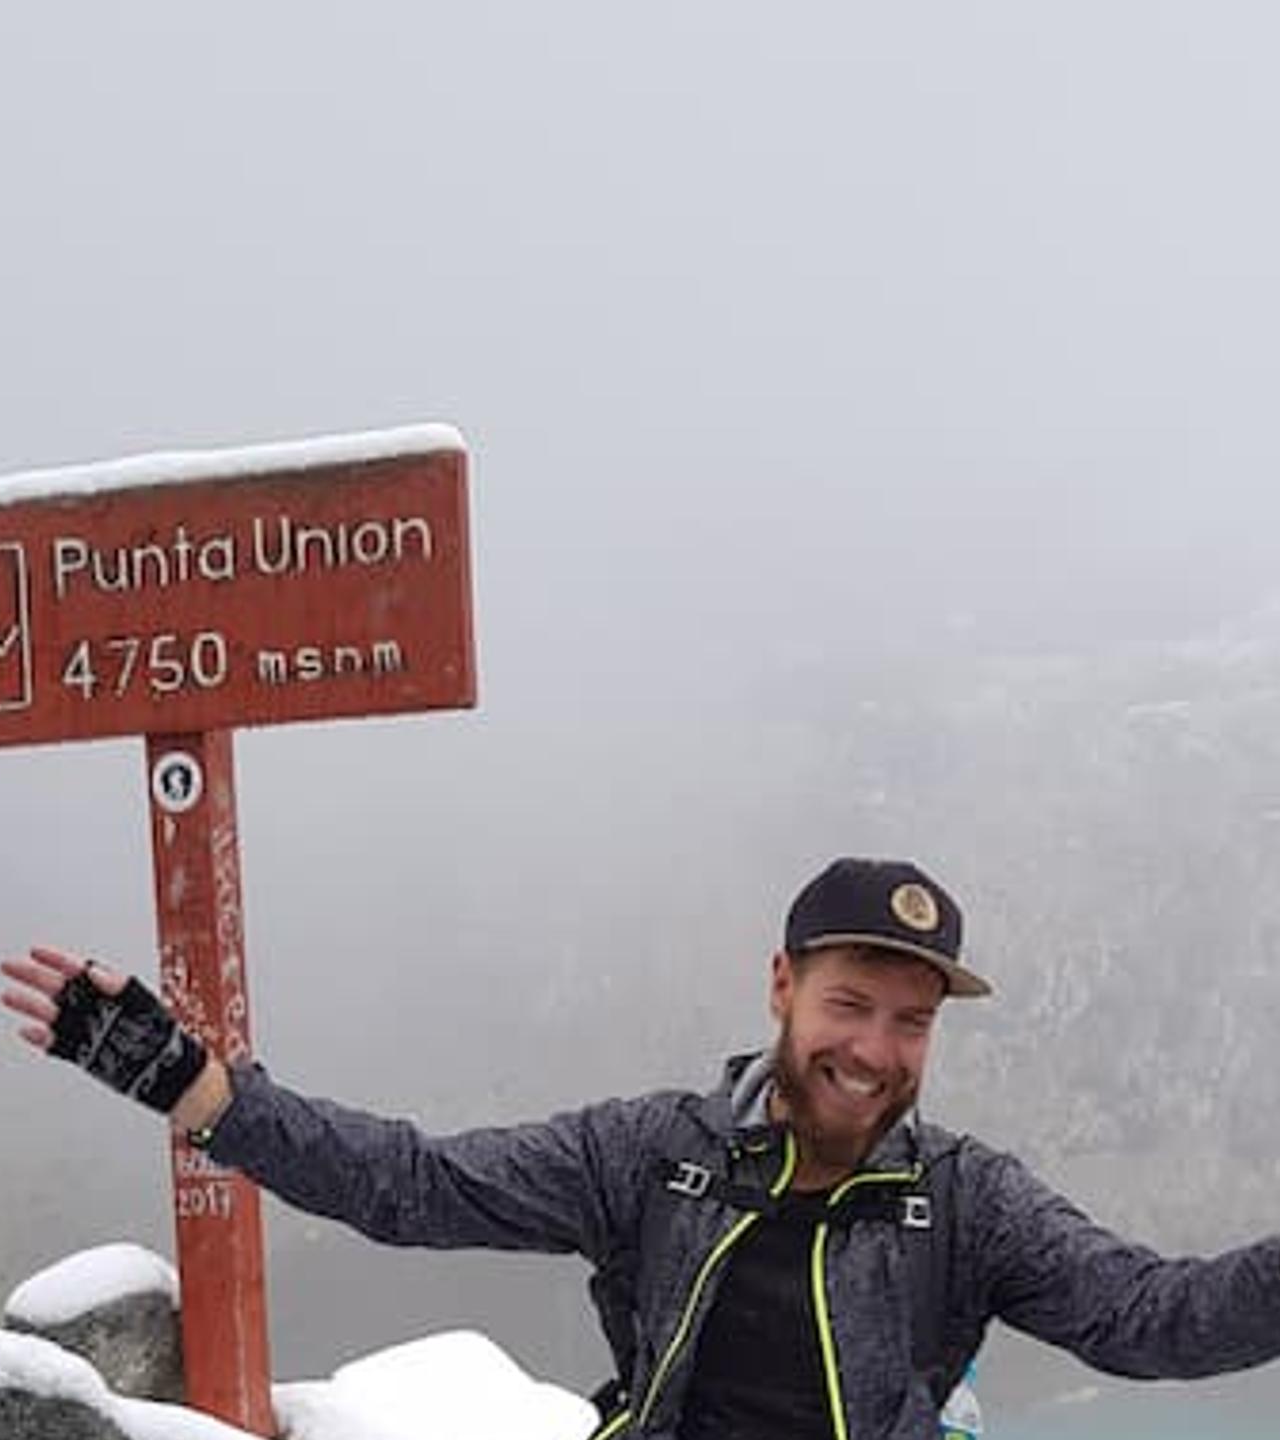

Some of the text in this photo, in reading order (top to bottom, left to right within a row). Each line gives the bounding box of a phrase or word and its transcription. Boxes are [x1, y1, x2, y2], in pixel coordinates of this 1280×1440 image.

[53, 515, 432, 599] Punta Union
[62, 631, 227, 699] 4750
